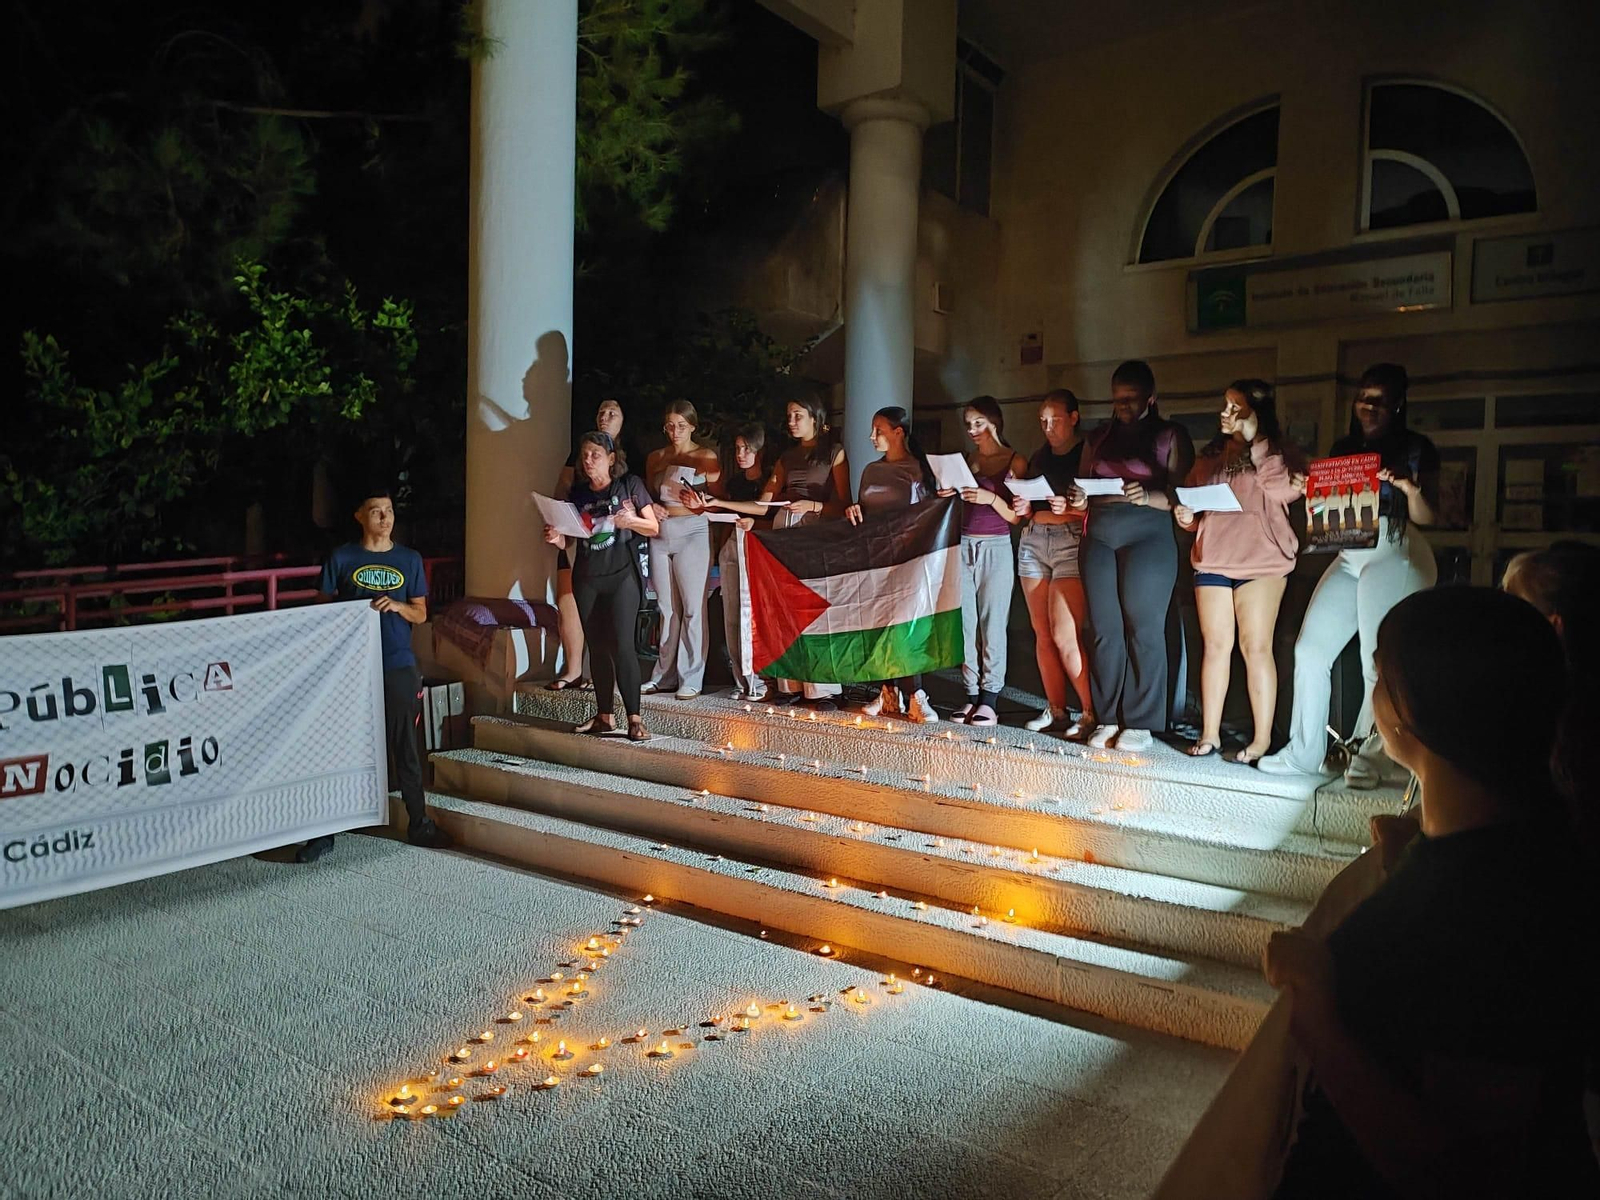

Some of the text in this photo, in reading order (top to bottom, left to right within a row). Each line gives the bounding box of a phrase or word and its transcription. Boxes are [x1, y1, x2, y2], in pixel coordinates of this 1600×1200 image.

[1373, 273, 1434, 288] Secundaria
[357, 568, 401, 586] QUIKSILVER
[3, 830, 95, 863] Cádiz
